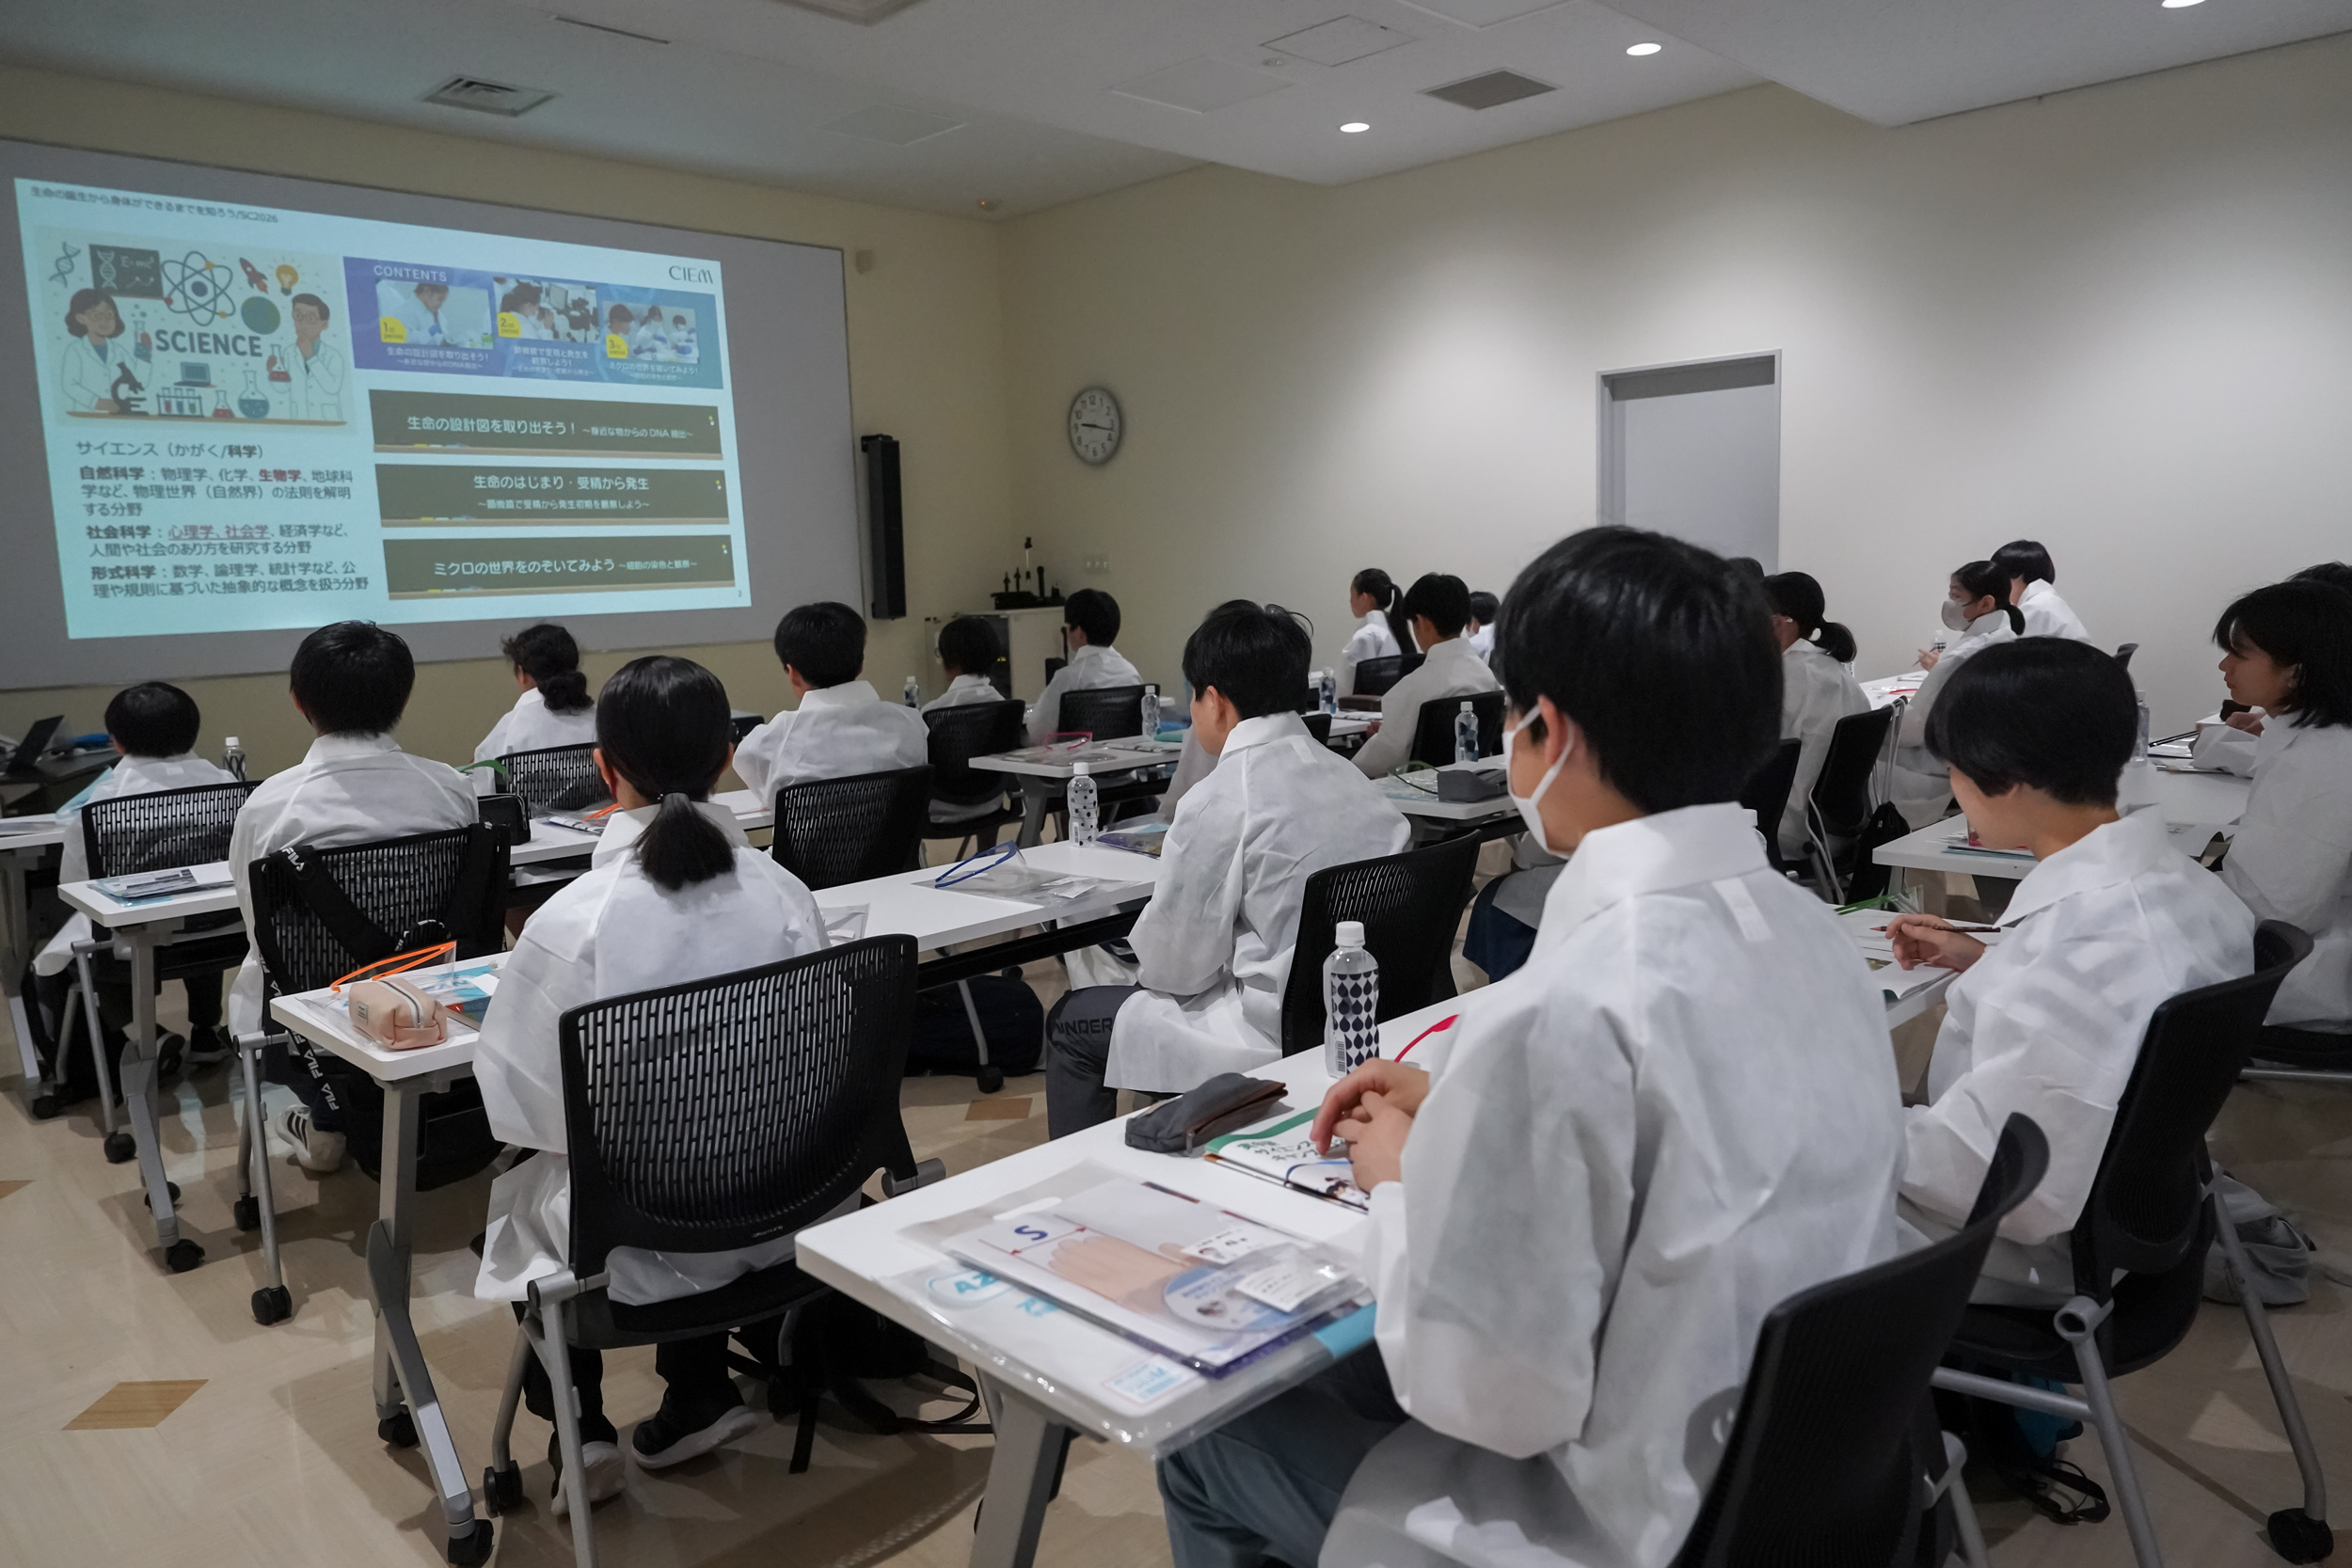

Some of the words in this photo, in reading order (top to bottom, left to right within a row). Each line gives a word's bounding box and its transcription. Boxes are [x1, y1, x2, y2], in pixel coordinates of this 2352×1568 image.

[373, 264, 448, 282] CONTENTS
[669, 265, 714, 284] CIEM
[154, 328, 263, 357] SCIENCE
[83, 501, 143, 516] する分野
[88, 540, 311, 558] 人間や社会のあり方を研究する分野
[435, 558, 615, 576] ミクロの世界をのぞいてみよう
[281, 847, 306, 872] FILA
[304, 1049, 324, 1080] FILA
[321, 1083, 340, 1111] FILA
[1013, 1224, 1049, 1242] S
